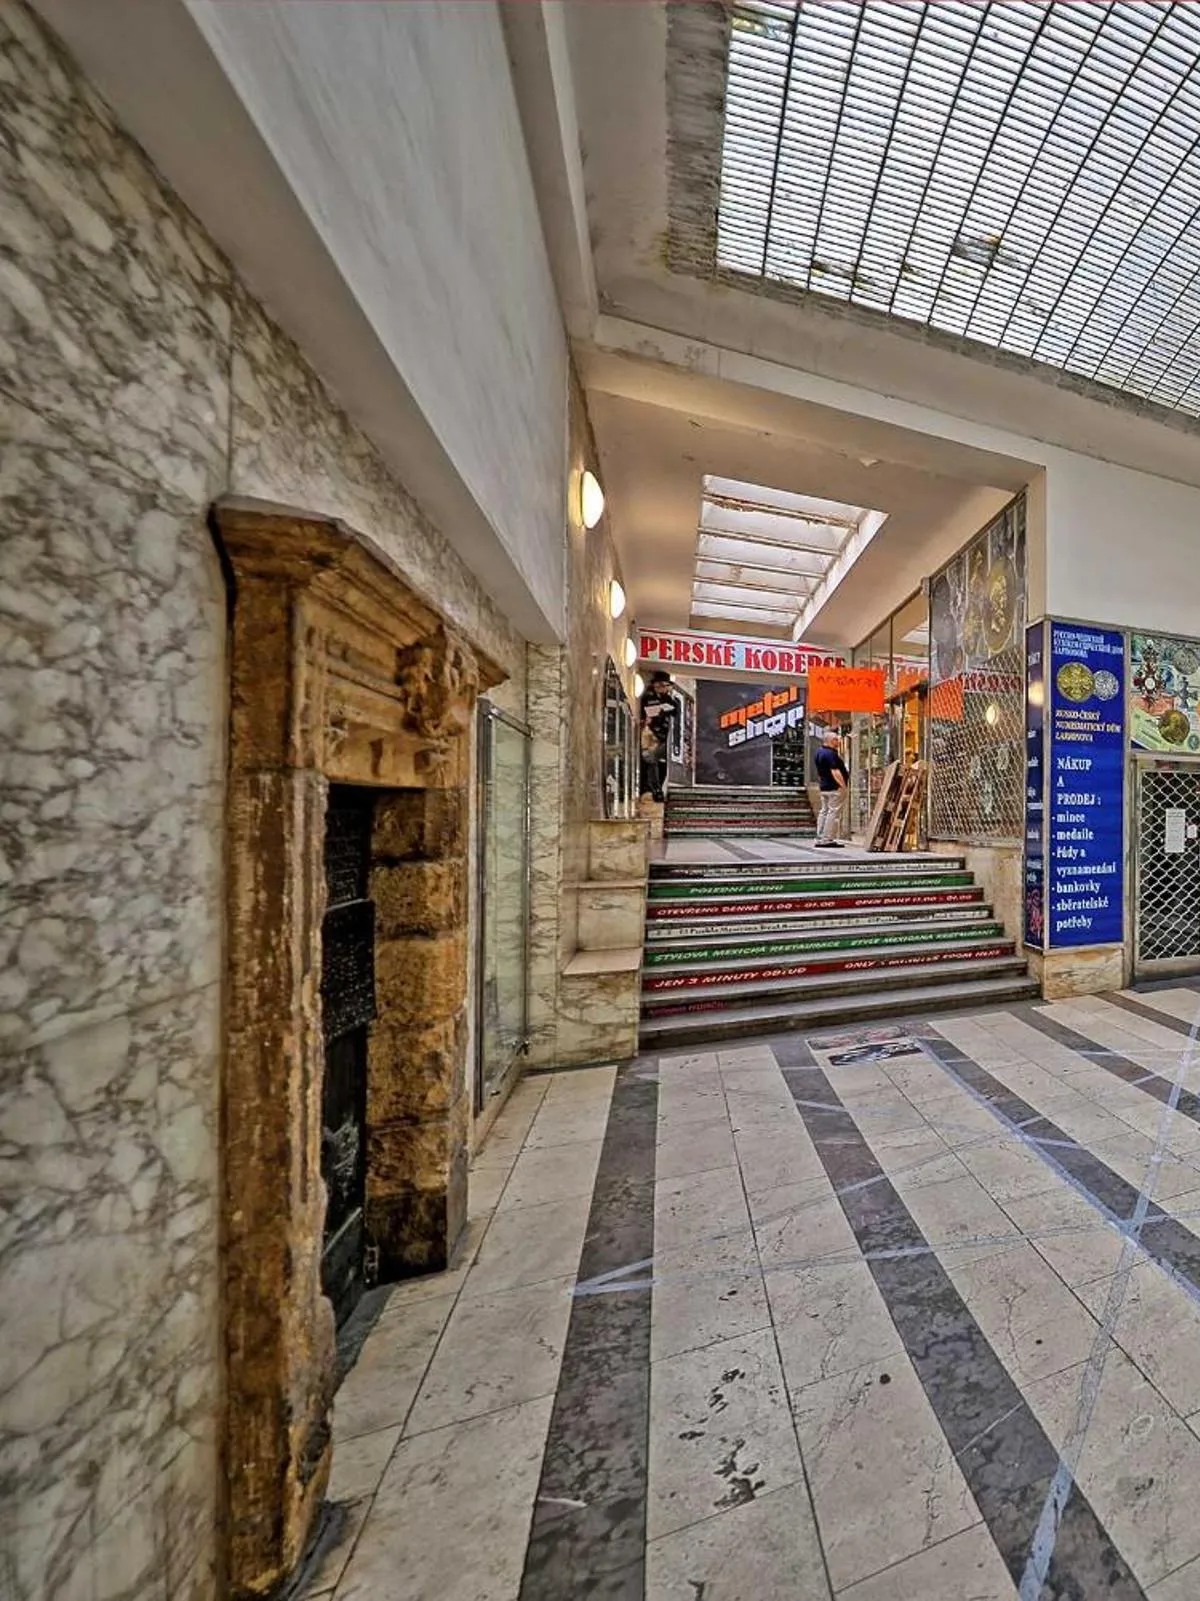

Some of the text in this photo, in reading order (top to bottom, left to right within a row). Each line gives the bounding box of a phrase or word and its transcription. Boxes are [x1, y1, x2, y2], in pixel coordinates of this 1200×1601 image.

[640, 636, 736, 667] PERSKÉ
[720, 686, 799, 730] metal
[728, 705, 804, 748] shop
[1057, 756, 1092, 770] NÁKUP
[1057, 776, 1064, 787] A
[1057, 813, 1085, 823] mince
[1057, 829, 1094, 840] medaile
[1057, 861, 1116, 878] vyznamenání
[1057, 880, 1100, 894] bankovky
[1057, 916, 1092, 932] potřeby
[844, 961, 876, 969] ONLY
[655, 979, 684, 988] JEN
[702, 972, 760, 984] MINUTY
